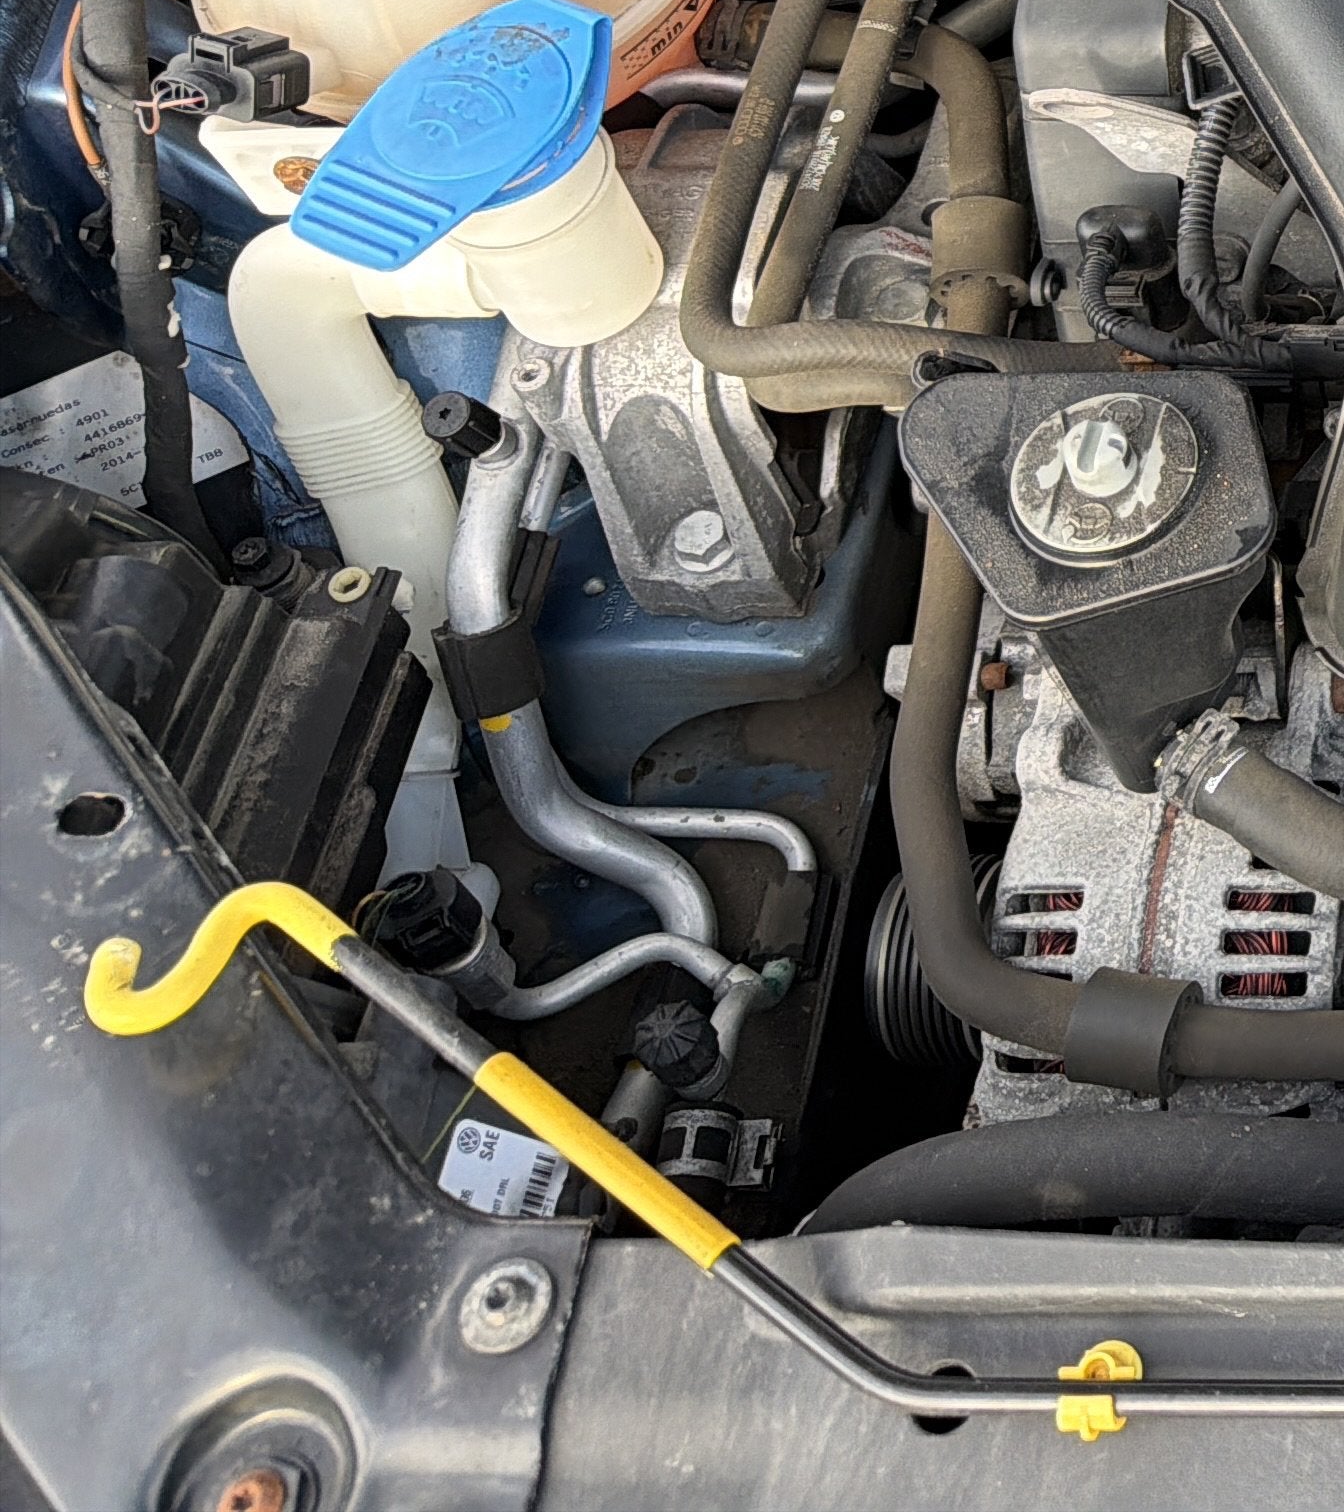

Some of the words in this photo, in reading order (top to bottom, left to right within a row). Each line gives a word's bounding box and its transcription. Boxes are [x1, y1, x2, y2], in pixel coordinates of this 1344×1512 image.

[651, 20, 684, 58] min
[1, 434, 50, 459] Consec
[75, 408, 110, 428] 4901
[479, 1130, 501, 1162] SAE
